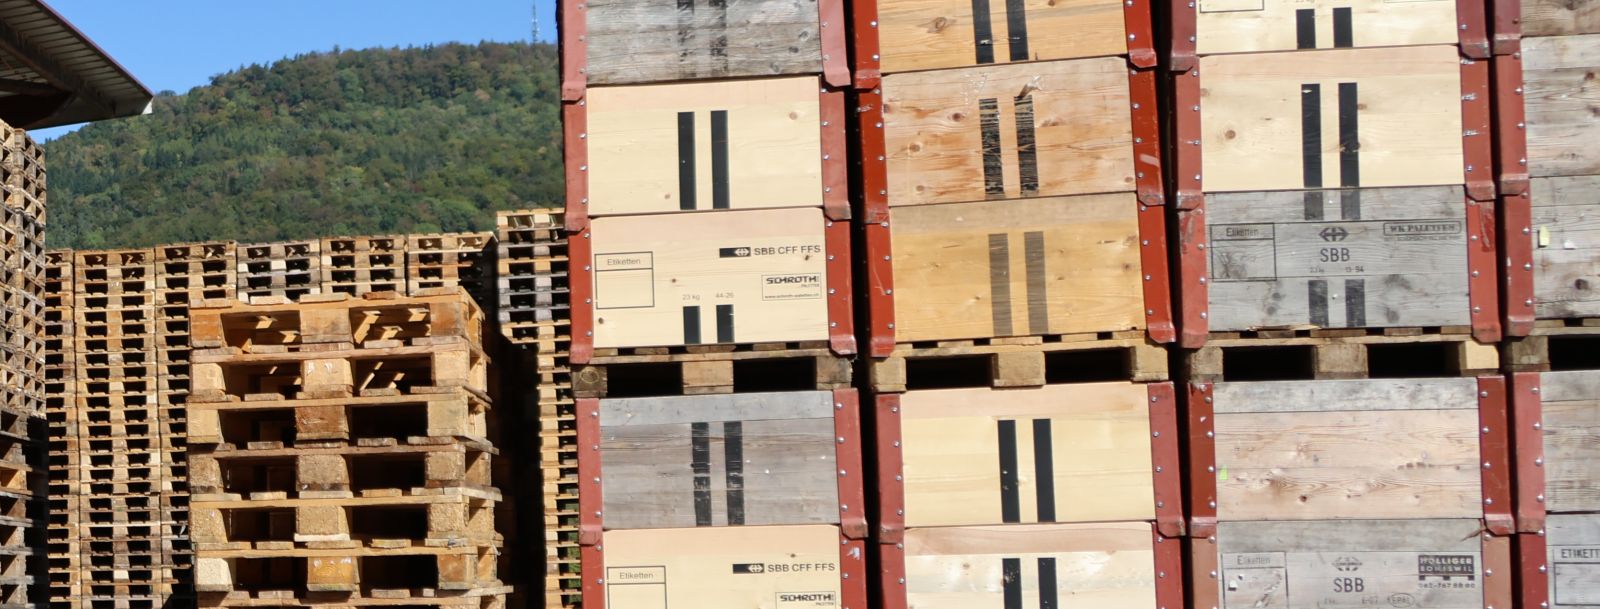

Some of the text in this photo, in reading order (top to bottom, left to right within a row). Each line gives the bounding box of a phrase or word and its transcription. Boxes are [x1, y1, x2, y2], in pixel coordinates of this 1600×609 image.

[754, 245, 821, 256] SBB CFF FFS
[1320, 248, 1350, 262] SBB
[607, 258, 641, 266] Etiketten
[767, 563, 835, 573] SBB CFF FFS
[619, 571, 654, 580] Etiketten
[1333, 577, 1365, 593] SBB
